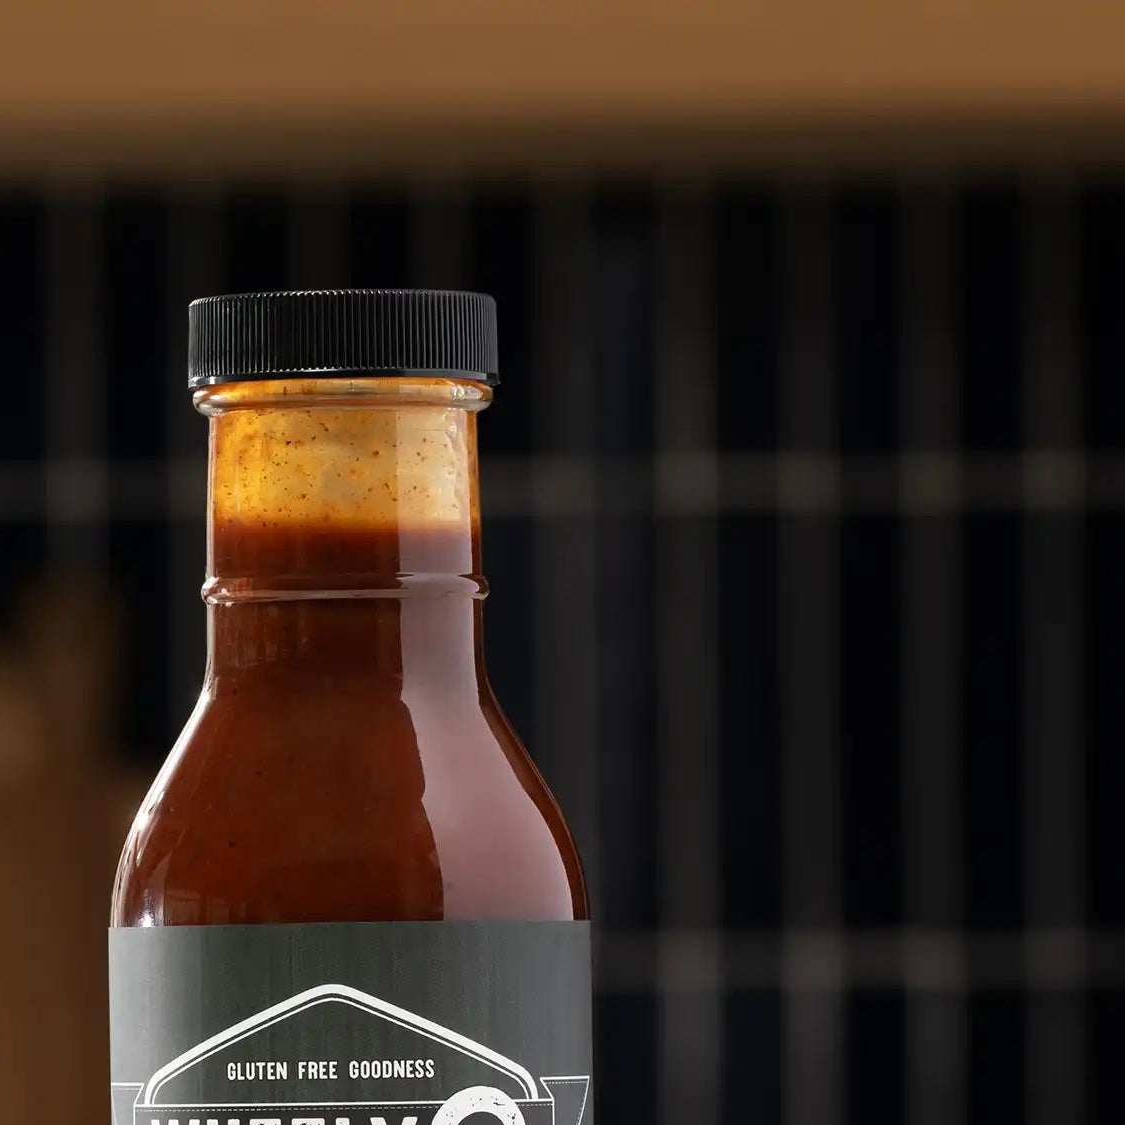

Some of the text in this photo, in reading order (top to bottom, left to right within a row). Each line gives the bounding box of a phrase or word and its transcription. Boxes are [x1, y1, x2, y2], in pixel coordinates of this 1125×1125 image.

[227, 1059, 435, 1081] GLUTEN FREE GOODNESS
